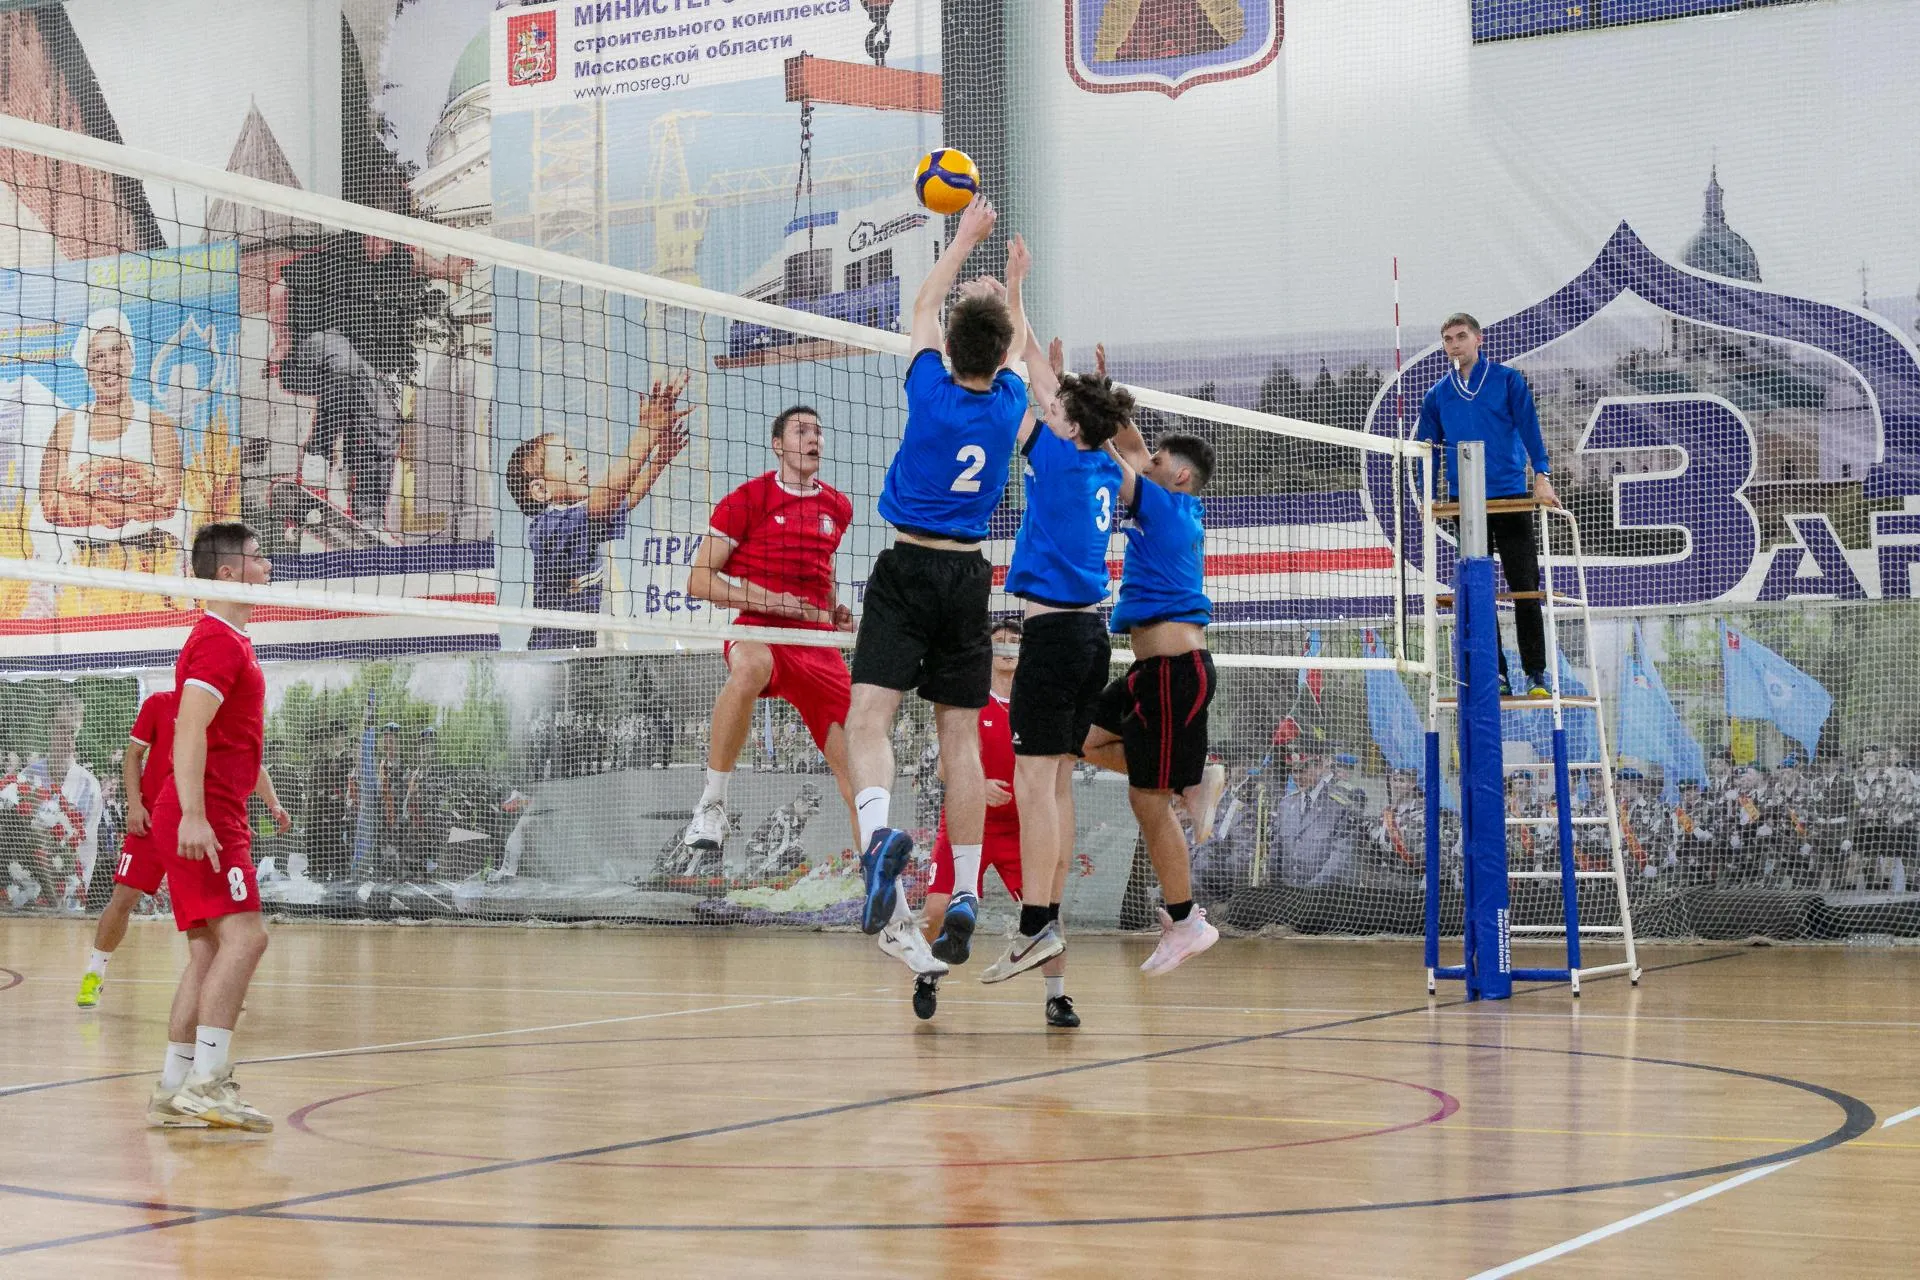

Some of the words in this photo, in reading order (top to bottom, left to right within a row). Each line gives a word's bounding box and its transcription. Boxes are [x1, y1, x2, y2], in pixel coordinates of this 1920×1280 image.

[574, 18, 725, 54] строительного
[732, 0, 851, 29] комплекса
[574, 44, 699, 78] Московской
[706, 34, 793, 59] области
[574, 72, 690, 100] www.mosreg.ru
[950, 444, 986, 493] 2
[1095, 486, 1111, 532] 3
[117, 852, 133, 877] 11
[227, 866, 248, 902] 8
[928, 862, 938, 886] 9
[1497, 908, 1506, 974] International
